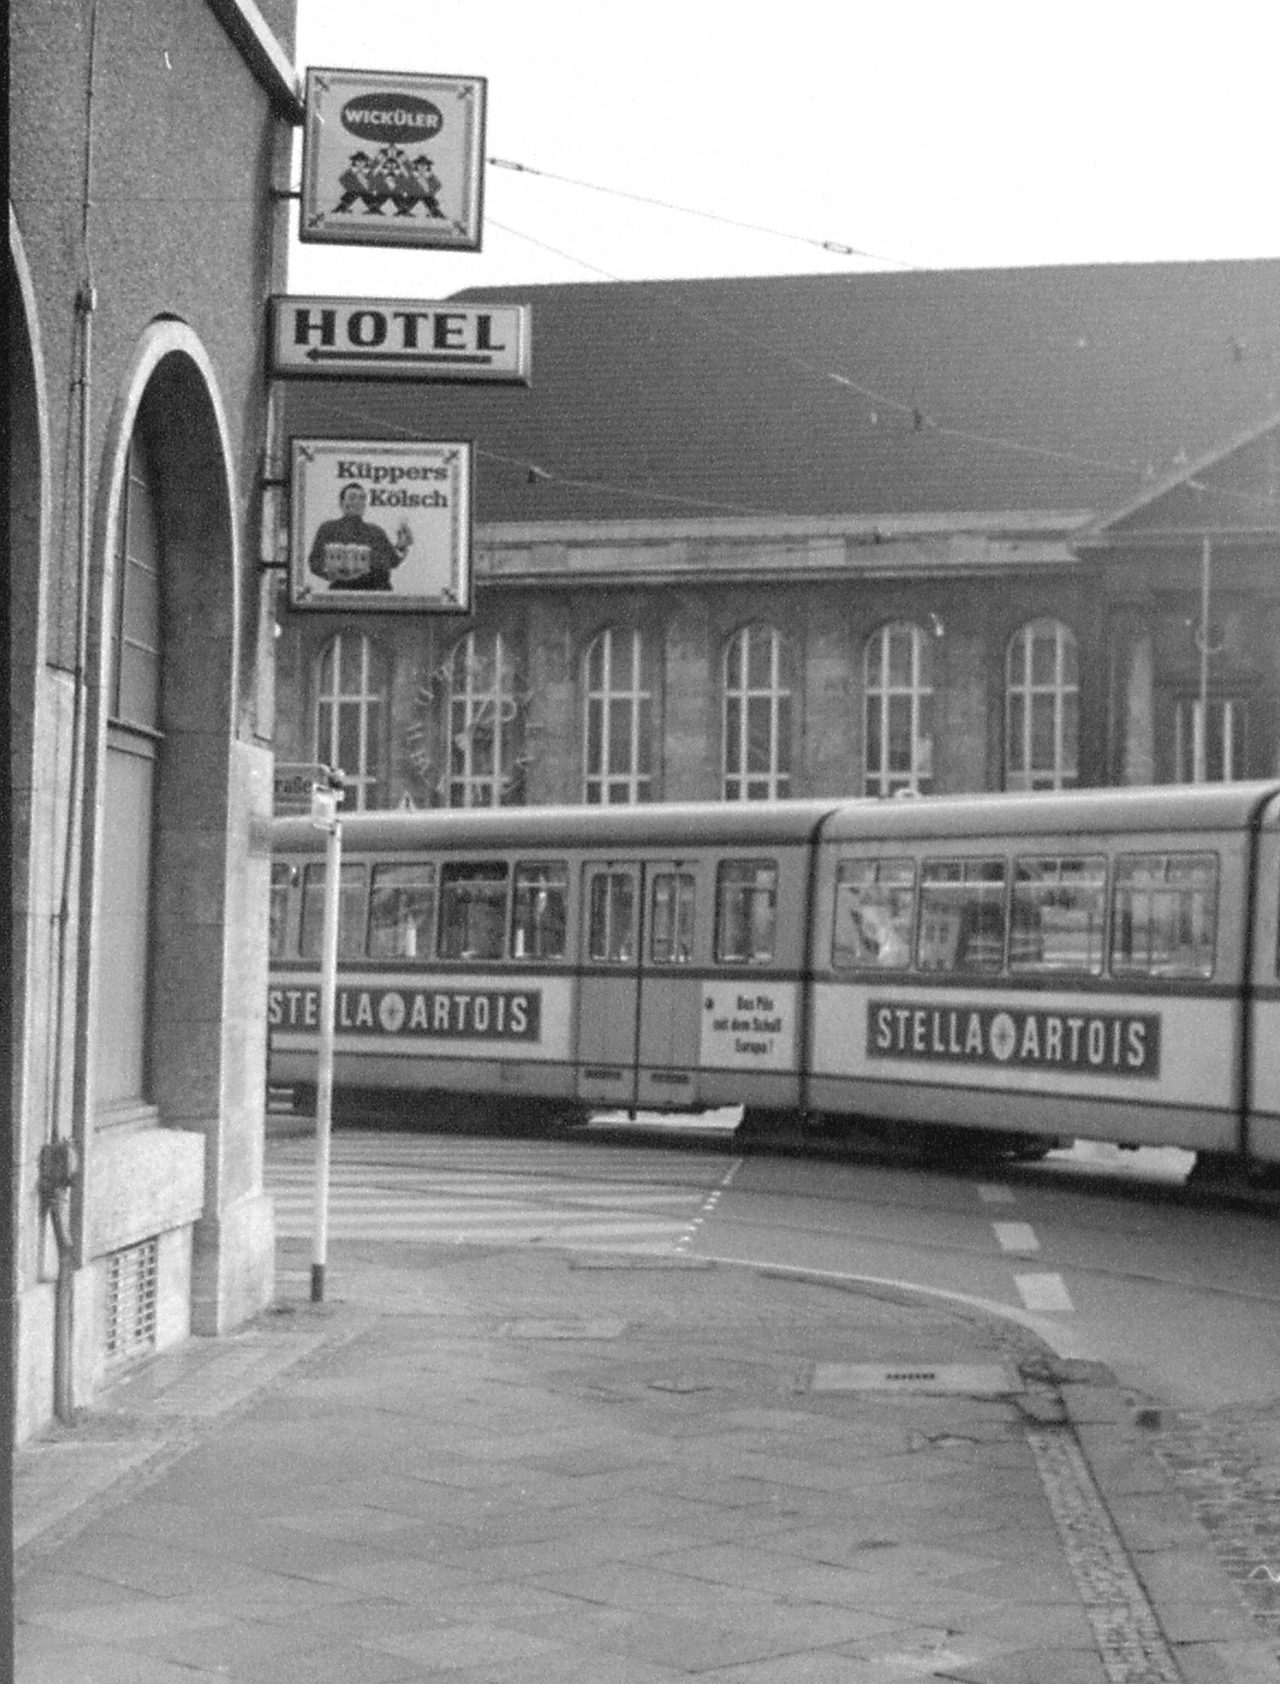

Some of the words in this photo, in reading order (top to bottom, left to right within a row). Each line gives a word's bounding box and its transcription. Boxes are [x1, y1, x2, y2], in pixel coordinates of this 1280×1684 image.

[344, 108, 439, 128] WICKÜLER
[294, 309, 505, 351] HOTEL
[337, 461, 448, 484] Küppers
[369, 488, 448, 508] Kölsch
[269, 991, 373, 1027] STELA
[409, 994, 528, 1033] ARTOIS
[876, 1007, 984, 1055] STELLA
[1020, 1015, 1147, 1068] ARTOIS
